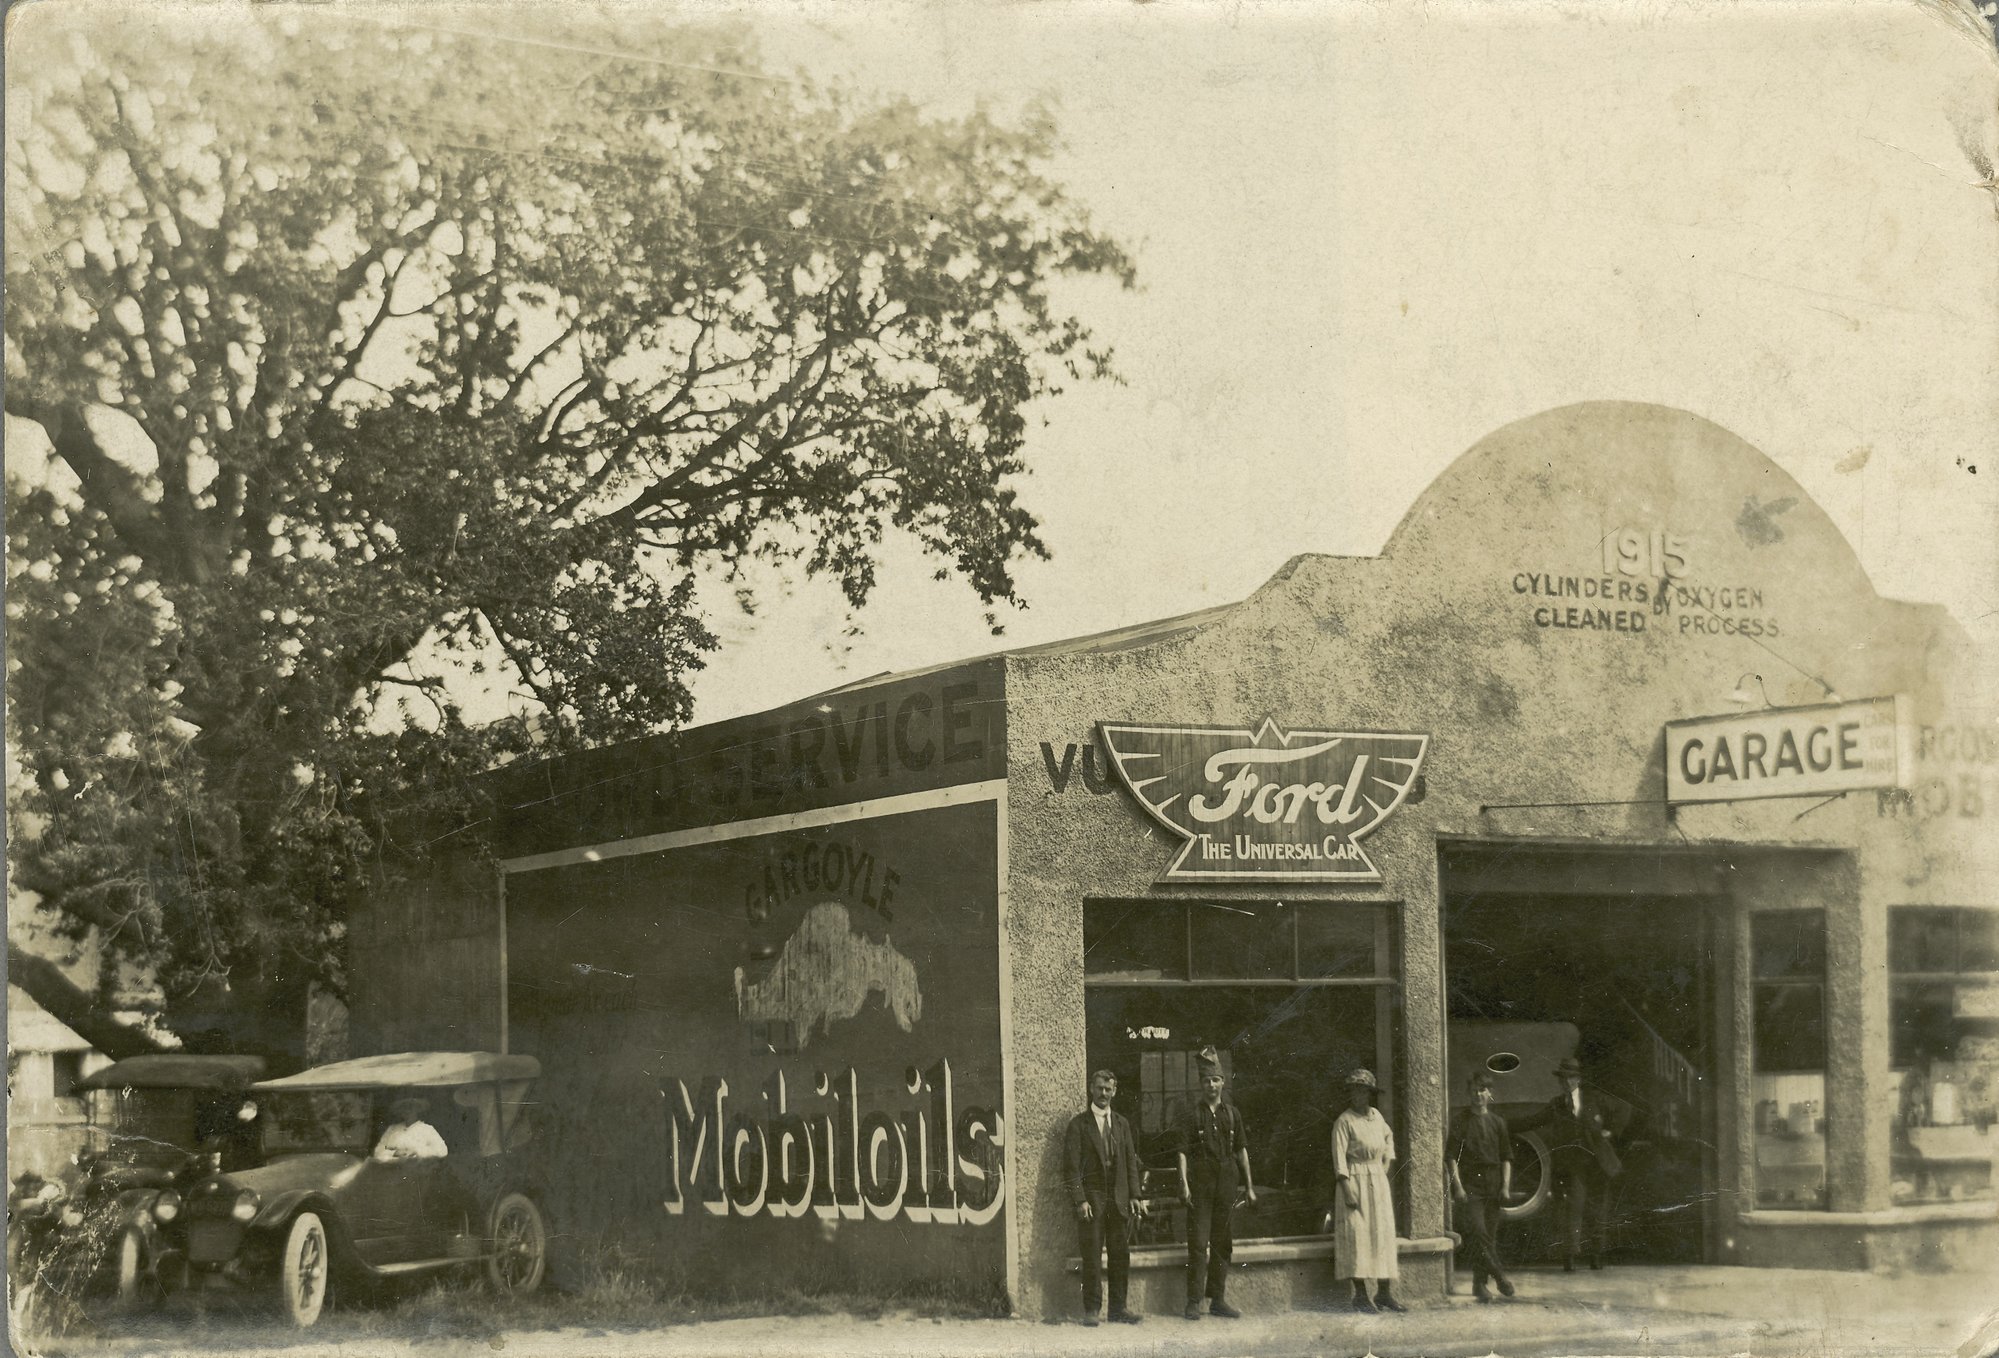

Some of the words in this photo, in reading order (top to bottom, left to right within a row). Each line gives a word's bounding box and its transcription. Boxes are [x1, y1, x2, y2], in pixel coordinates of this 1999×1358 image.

[1601, 526, 1690, 579] 1915
[1513, 572, 1650, 603] CYLINDERS
[1677, 586, 1763, 609] OXYGEN
[1534, 607, 1646, 632] CLEANED
[1679, 614, 1780, 637] PROCESS
[711, 682, 983, 805] SERVICE
[1681, 721, 1863, 784] GARAGE
[1189, 738, 1369, 824] Ford
[1199, 834, 1231, 860] THE
[1236, 834, 1322, 861] UNIVERSAL
[1323, 834, 1359, 861] CAR
[745, 841, 901, 925] GARGOYLE
[660, 1057, 1005, 1226] Mobiloils
